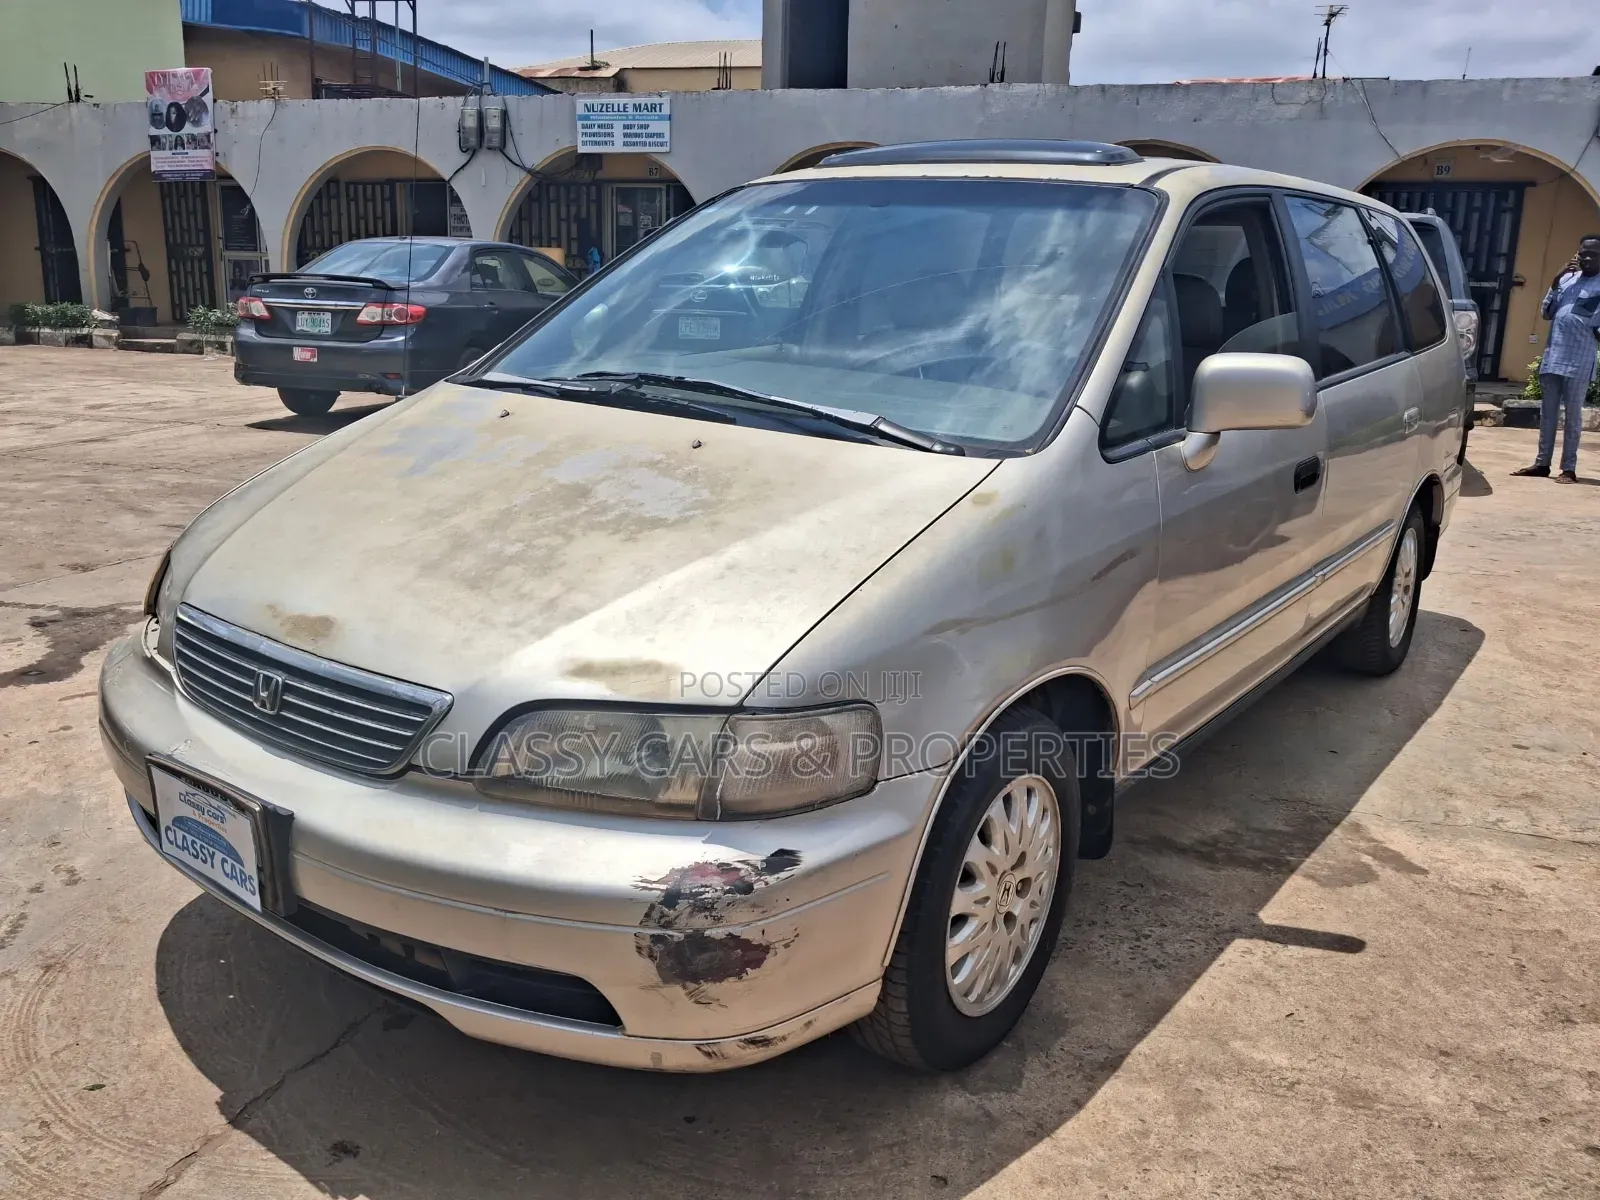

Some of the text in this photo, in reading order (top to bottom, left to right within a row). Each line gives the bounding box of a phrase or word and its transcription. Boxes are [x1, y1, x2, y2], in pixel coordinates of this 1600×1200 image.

[584, 103, 664, 113] NUZELLE MART
[648, 167, 659, 177] B7
[1435, 164, 1451, 176] B9
[164, 825, 216, 869] CLASSY
[220, 856, 257, 897] CARS
